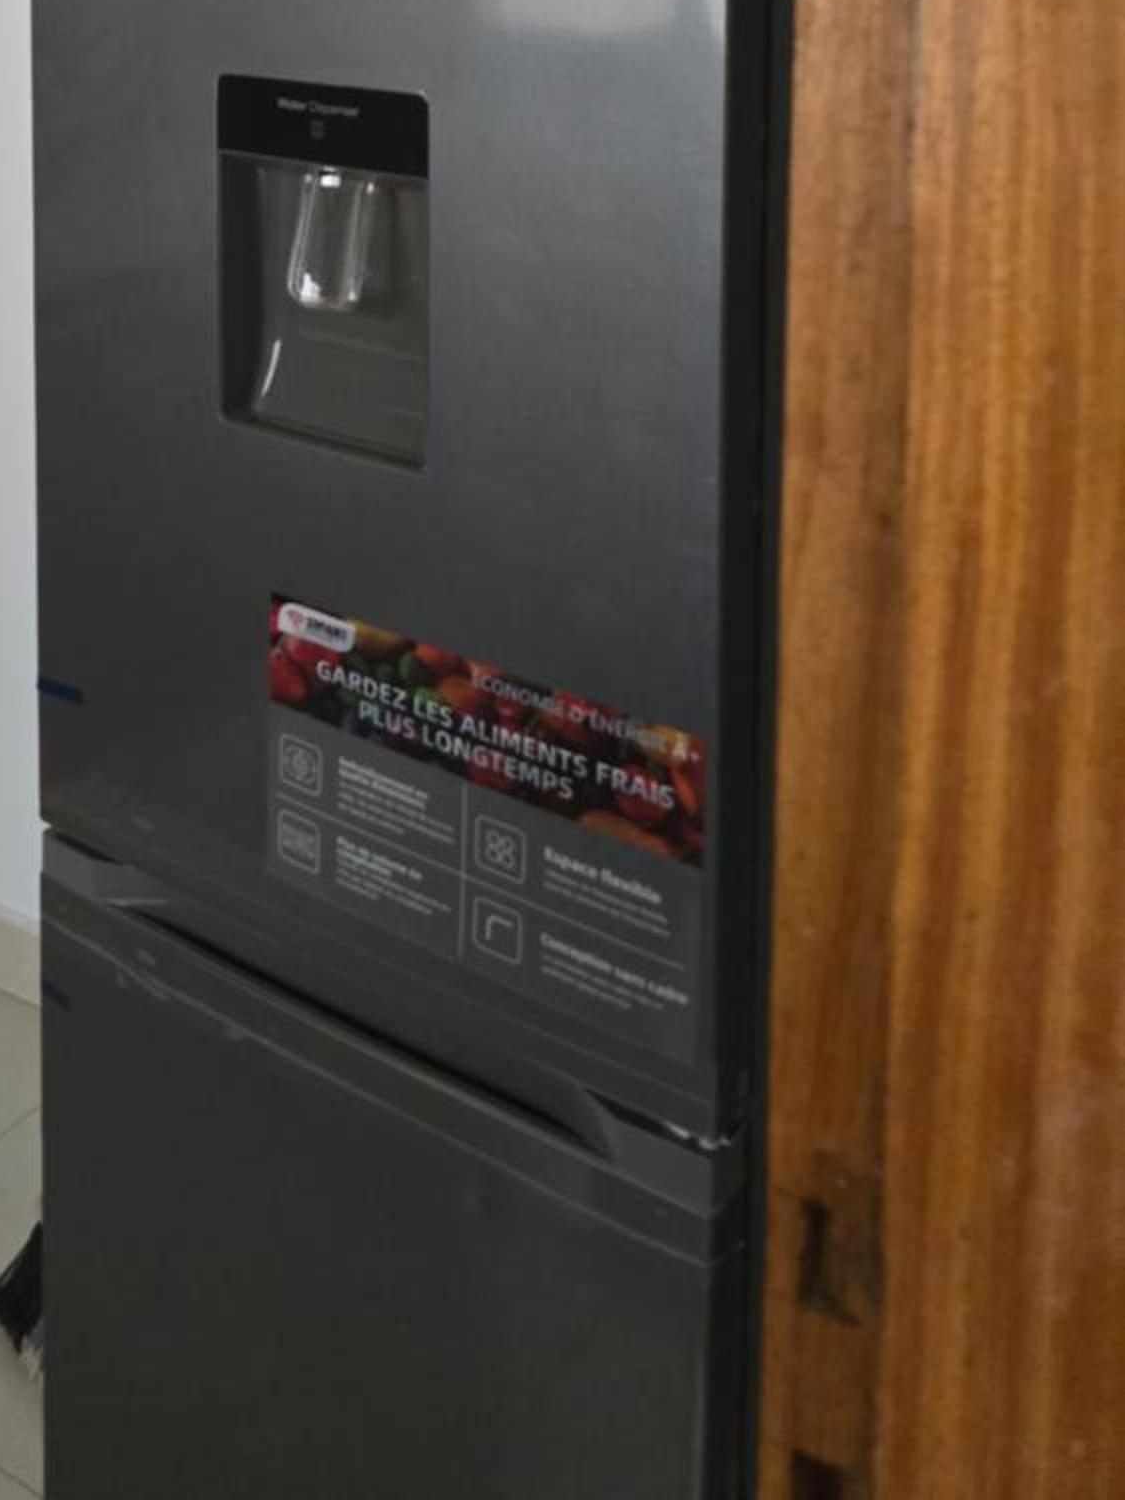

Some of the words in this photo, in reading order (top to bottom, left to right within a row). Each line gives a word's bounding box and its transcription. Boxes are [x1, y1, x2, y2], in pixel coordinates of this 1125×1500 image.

[316, 659, 407, 712] GARDEZ
[412, 696, 454, 728] LES
[459, 712, 589, 779] ALIMENTS
[595, 761, 677, 811] FRAIS
[358, 700, 418, 741] PLUS
[421, 723, 576, 801] LONGTEMPS
